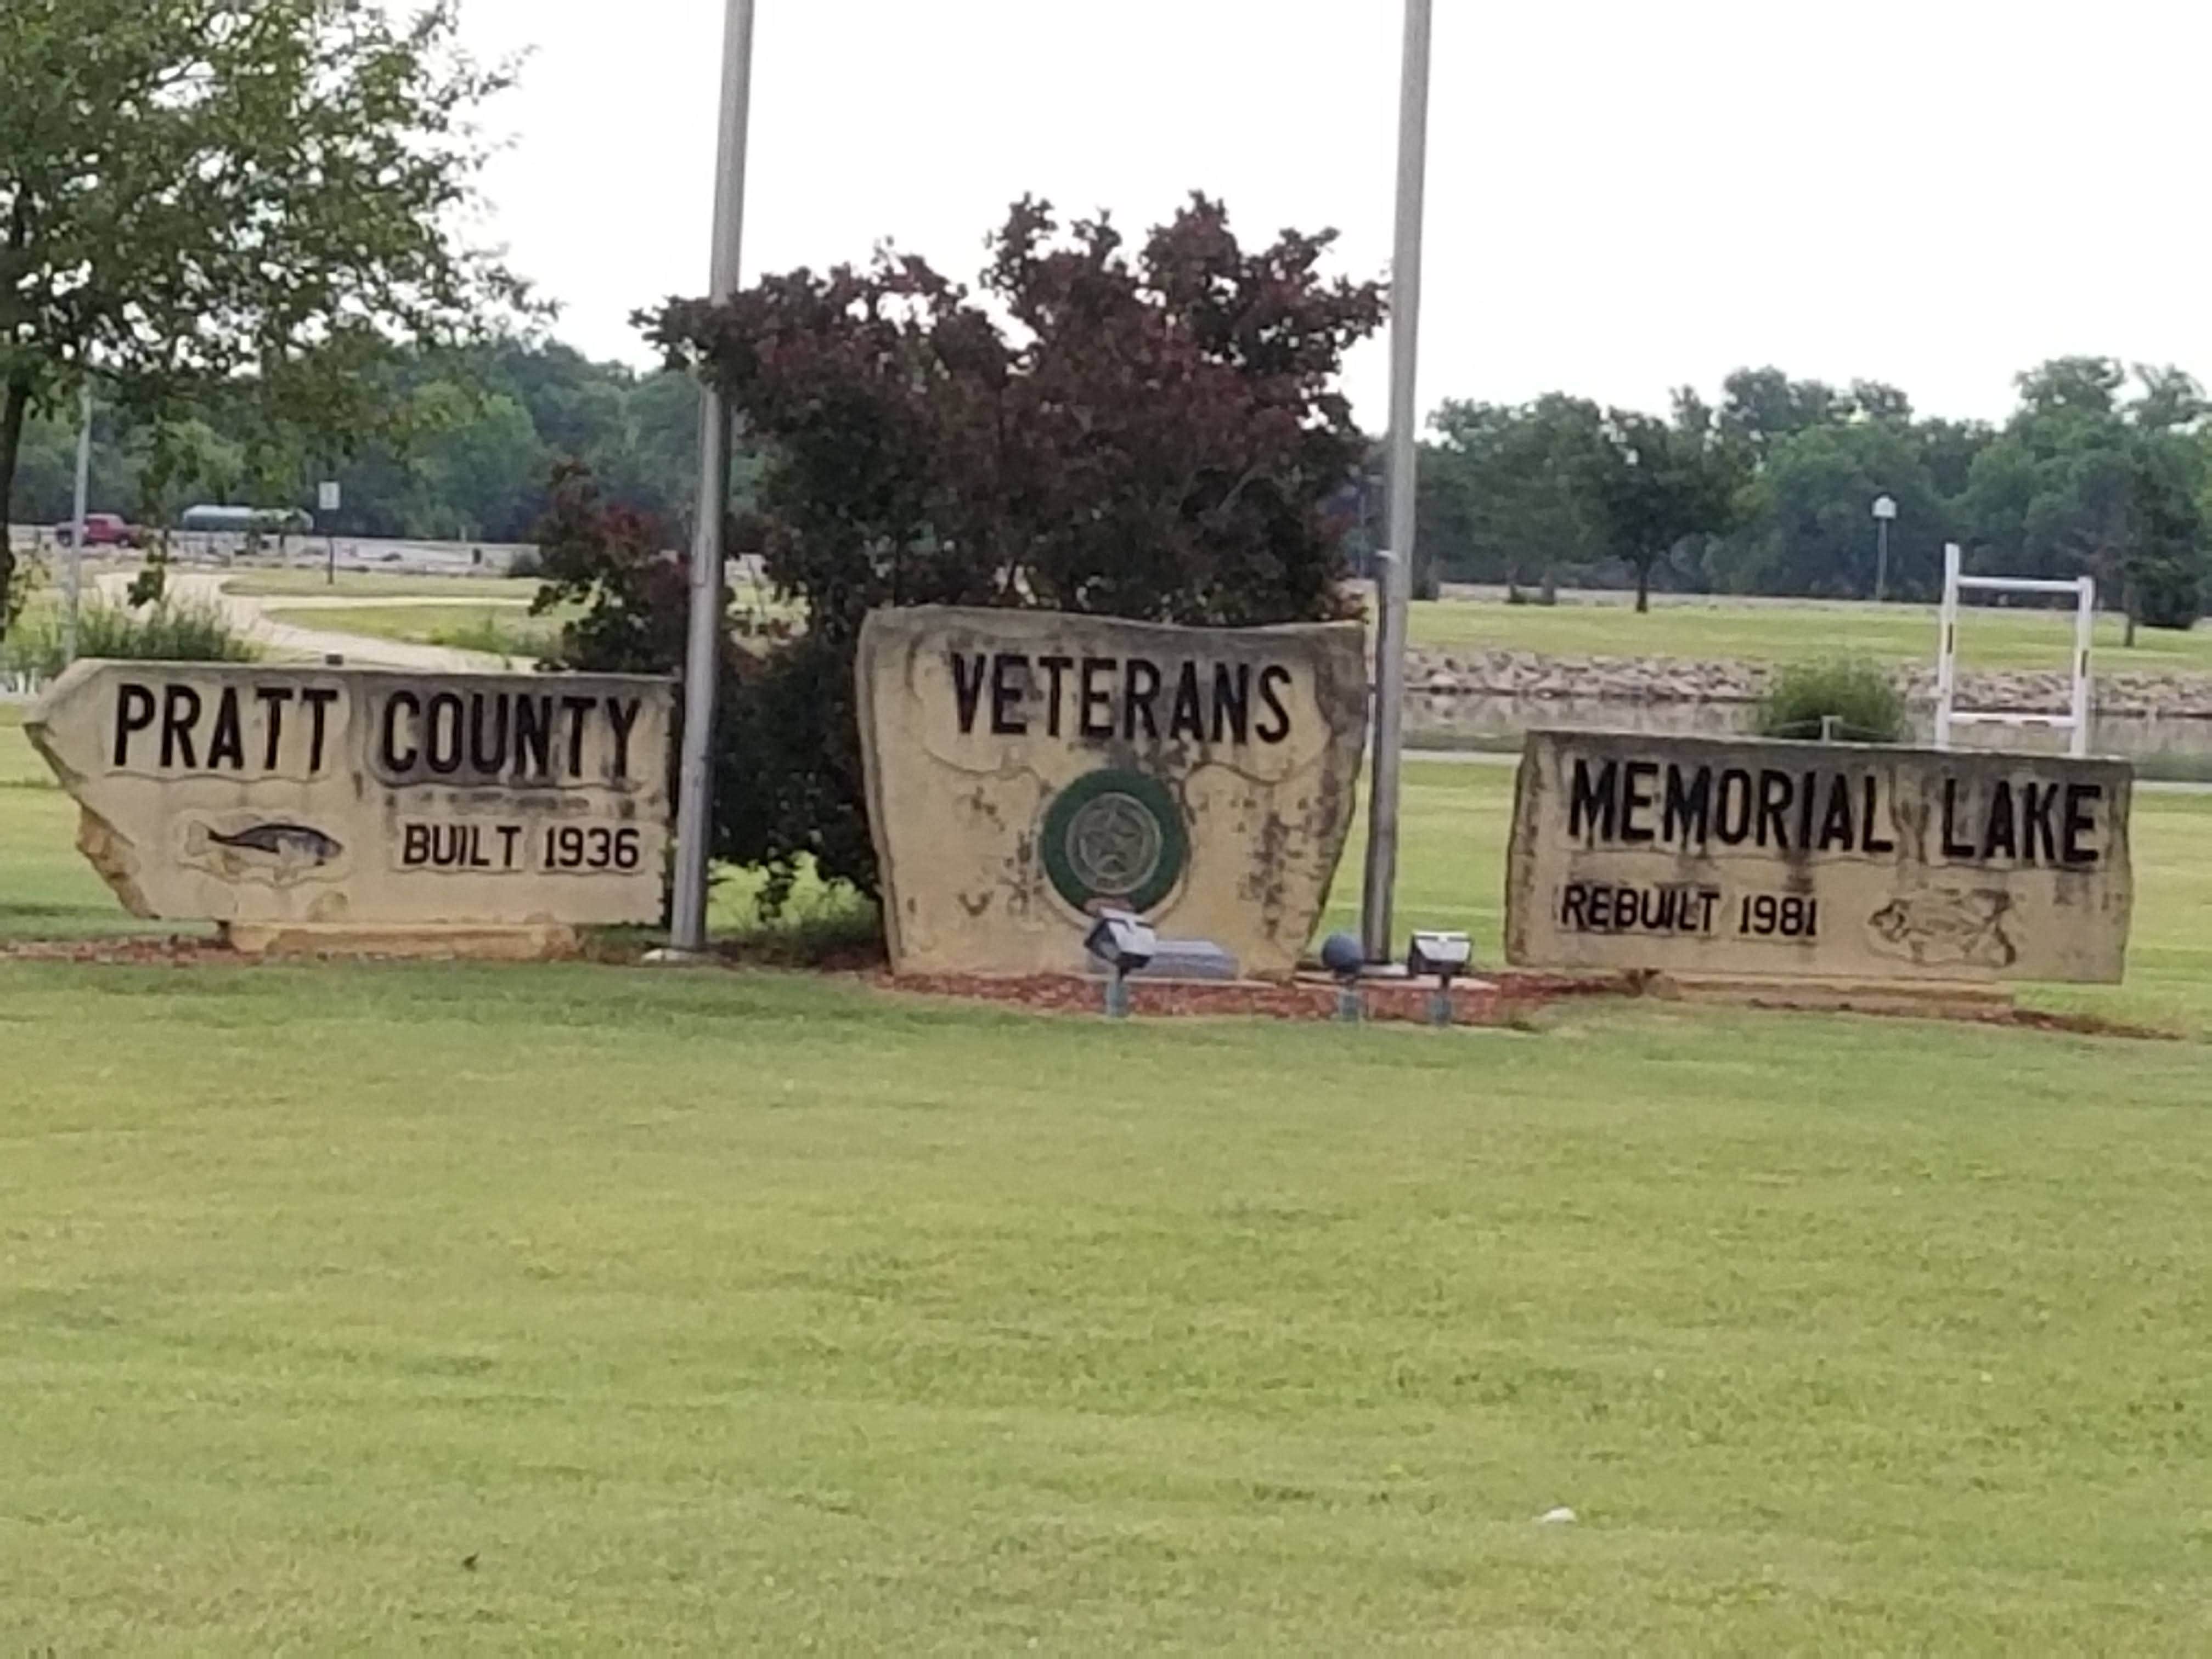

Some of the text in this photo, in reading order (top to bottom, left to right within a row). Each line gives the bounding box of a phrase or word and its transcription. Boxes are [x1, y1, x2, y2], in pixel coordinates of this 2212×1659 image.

[114, 683, 641, 778] PRATT COUNTY
[951, 653, 1293, 745] VETERANS
[402, 822, 640, 868] BUILT 1936
[1567, 758, 2102, 862] MEMORIAL LAKE
[1561, 884, 1818, 937] REBUILT 1981
